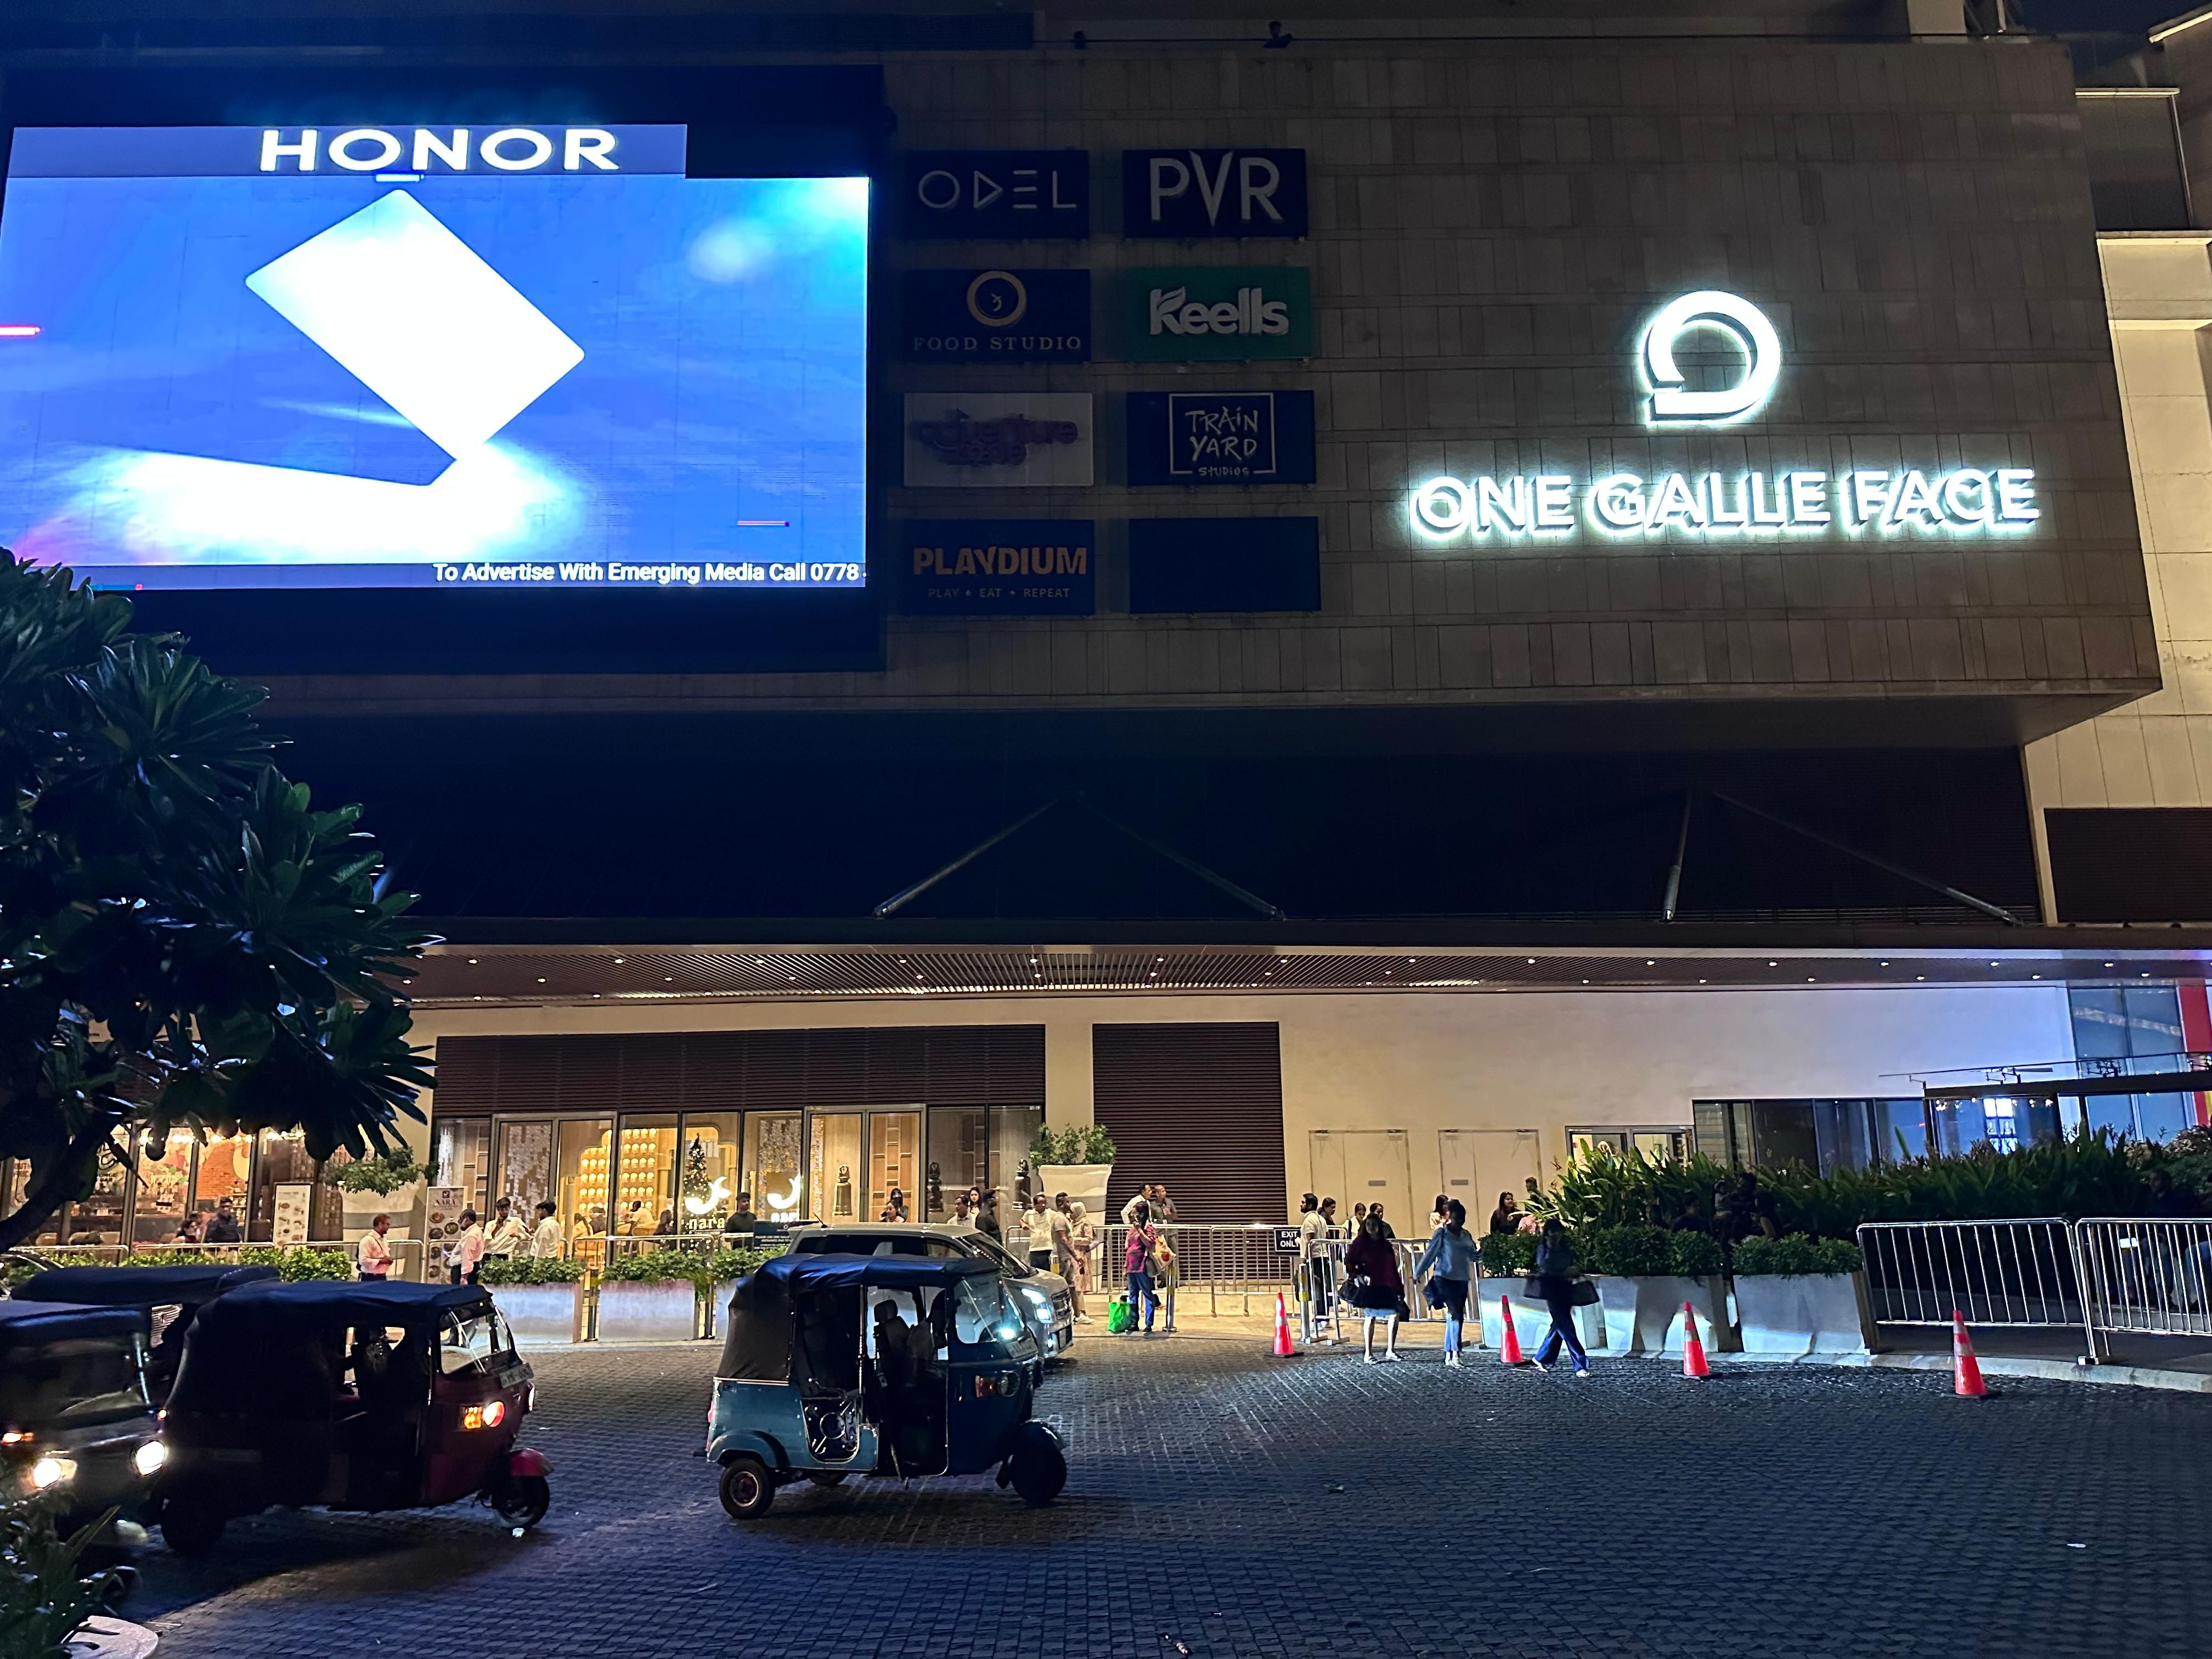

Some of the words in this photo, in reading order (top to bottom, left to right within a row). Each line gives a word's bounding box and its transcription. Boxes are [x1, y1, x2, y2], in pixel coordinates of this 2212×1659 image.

[260, 128, 619, 171] HONOR
[918, 170, 1077, 210] ODEL
[1149, 149, 1284, 227] PVR
[1150, 286, 1289, 335] Keells
[913, 336, 978, 351] FOOD
[990, 336, 1081, 351] STUDIO
[1189, 435, 1257, 461] YARD
[1417, 475, 1575, 532] ONE
[1593, 471, 1831, 530] GALLE
[1847, 467, 2040, 526] FACE
[432, 563, 459, 581] To
[461, 562, 555, 581] Advertise
[558, 562, 604, 581] With
[607, 562, 701, 585] Emerging
[705, 562, 765, 580] Media
[769, 562, 806, 580] Call
[810, 563, 860, 580] 0778
[913, 546, 1087, 575] PLAYDIUM
[928, 588, 960, 597] PLAY
[980, 588, 1001, 597] EAT
[1024, 588, 1070, 597] REPEAT
